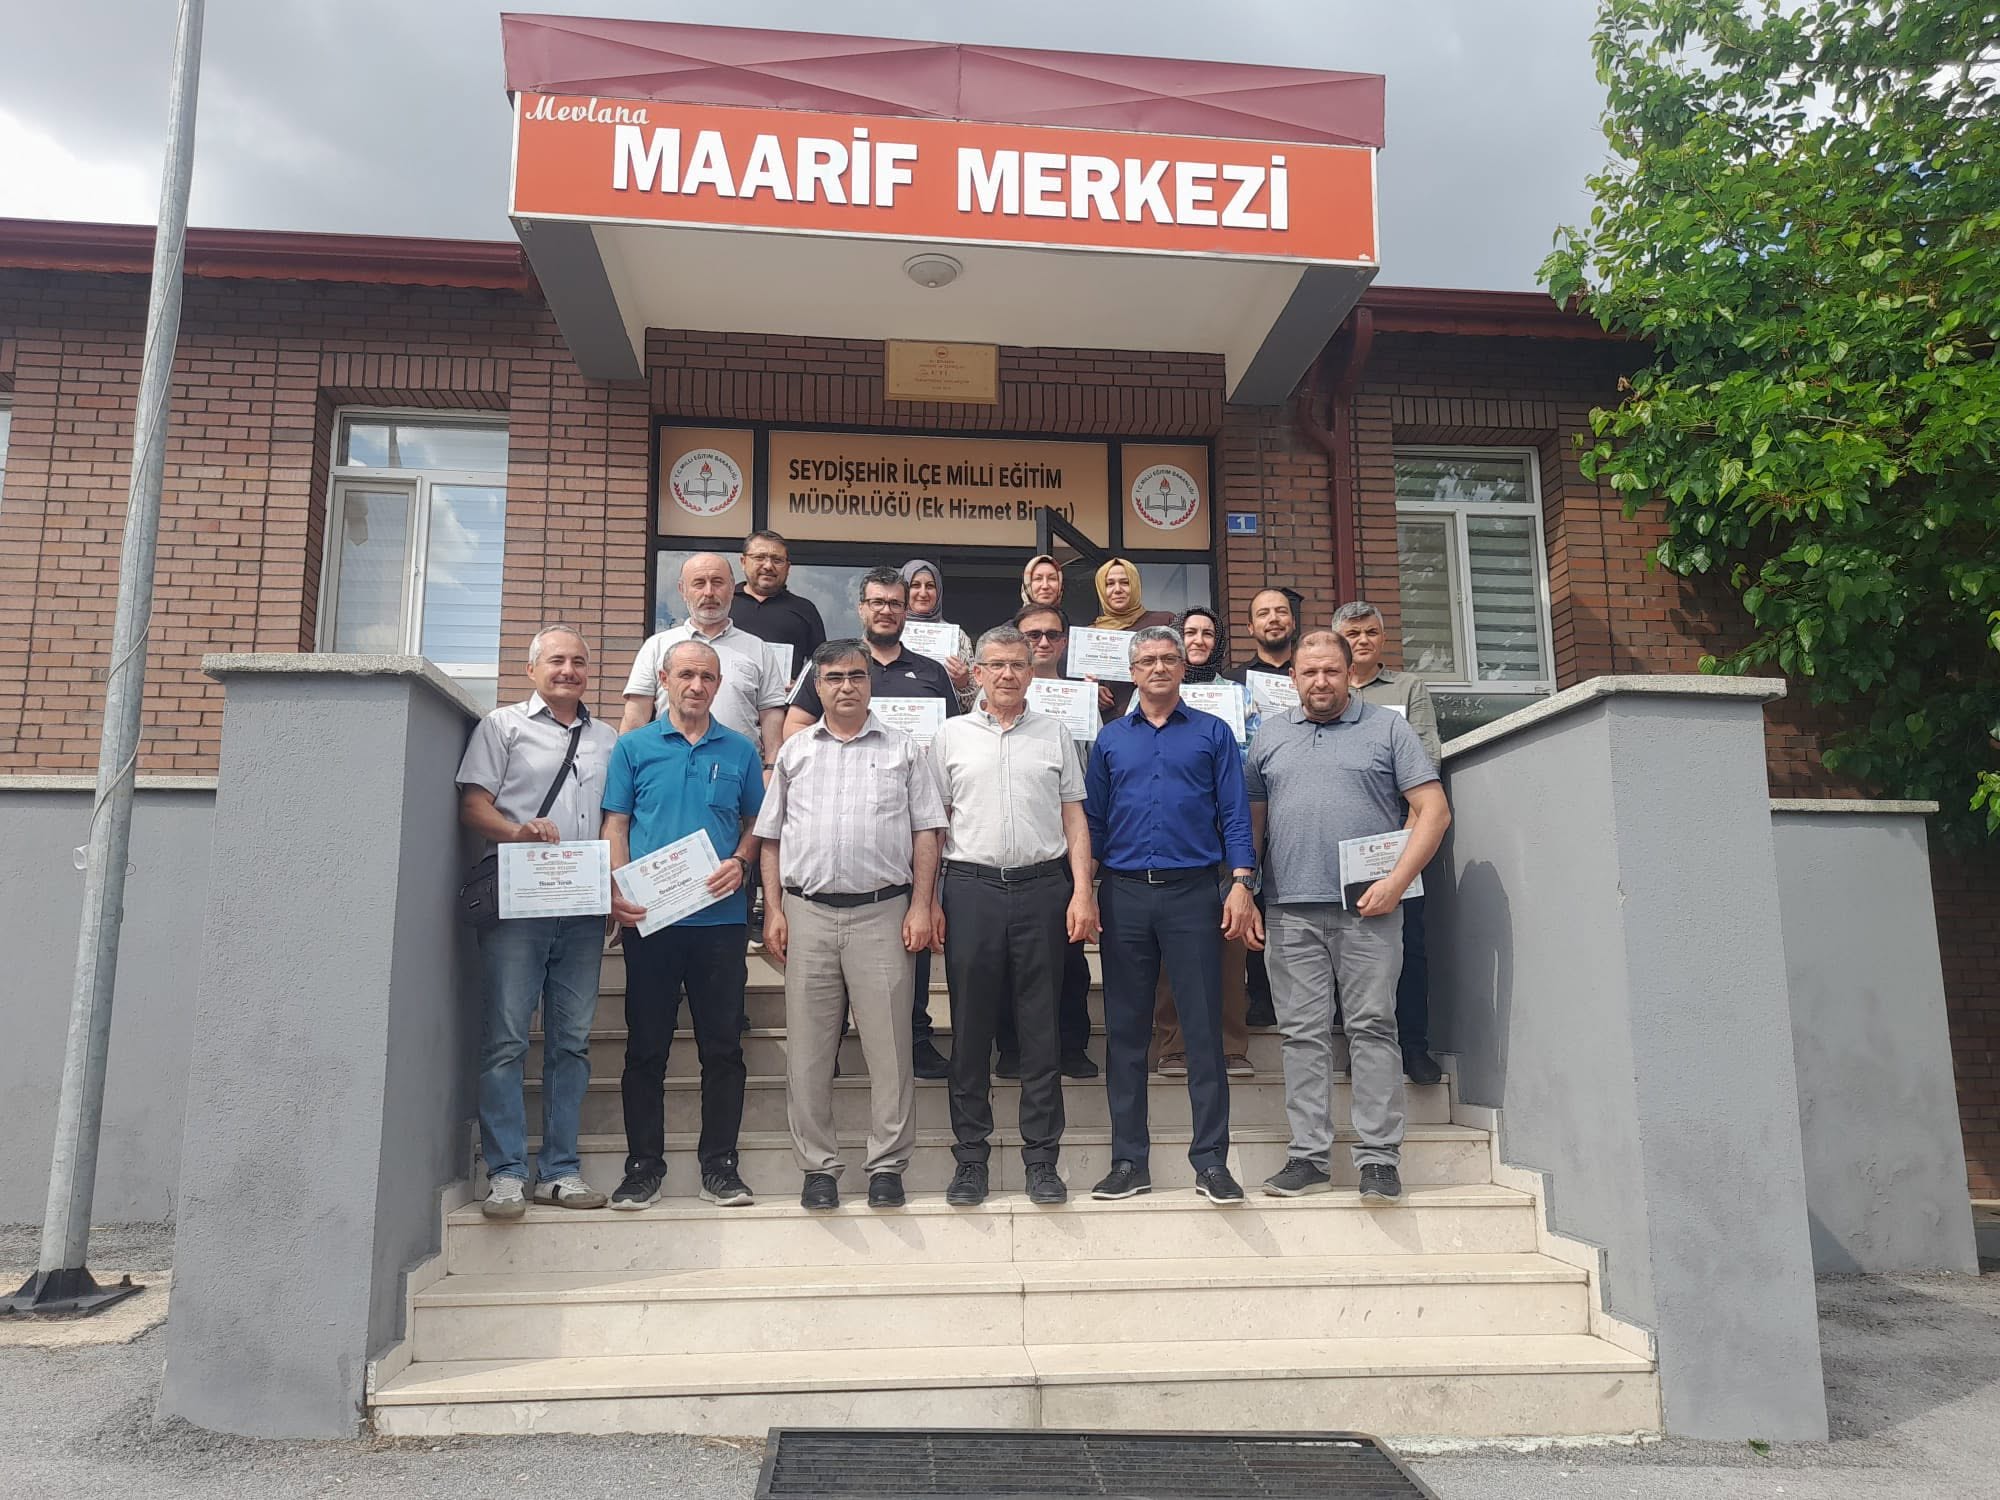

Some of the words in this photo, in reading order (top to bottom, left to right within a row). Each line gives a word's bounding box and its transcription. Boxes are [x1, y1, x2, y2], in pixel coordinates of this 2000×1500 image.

[525, 95, 650, 124] Mevlana
[613, 124, 918, 207] MAARİF
[957, 147, 1289, 230] MERKEZİ
[789, 455, 898, 488] SEYDİŞEHİR
[903, 458, 942, 491] İLÇE
[999, 462, 1062, 489] EĞİTİM
[789, 487, 911, 517] MÜDÜRLÜĞÜ
[916, 496, 944, 522] (Ek
[949, 498, 1012, 521] Hizmet
[1236, 516, 1246, 529] 1
